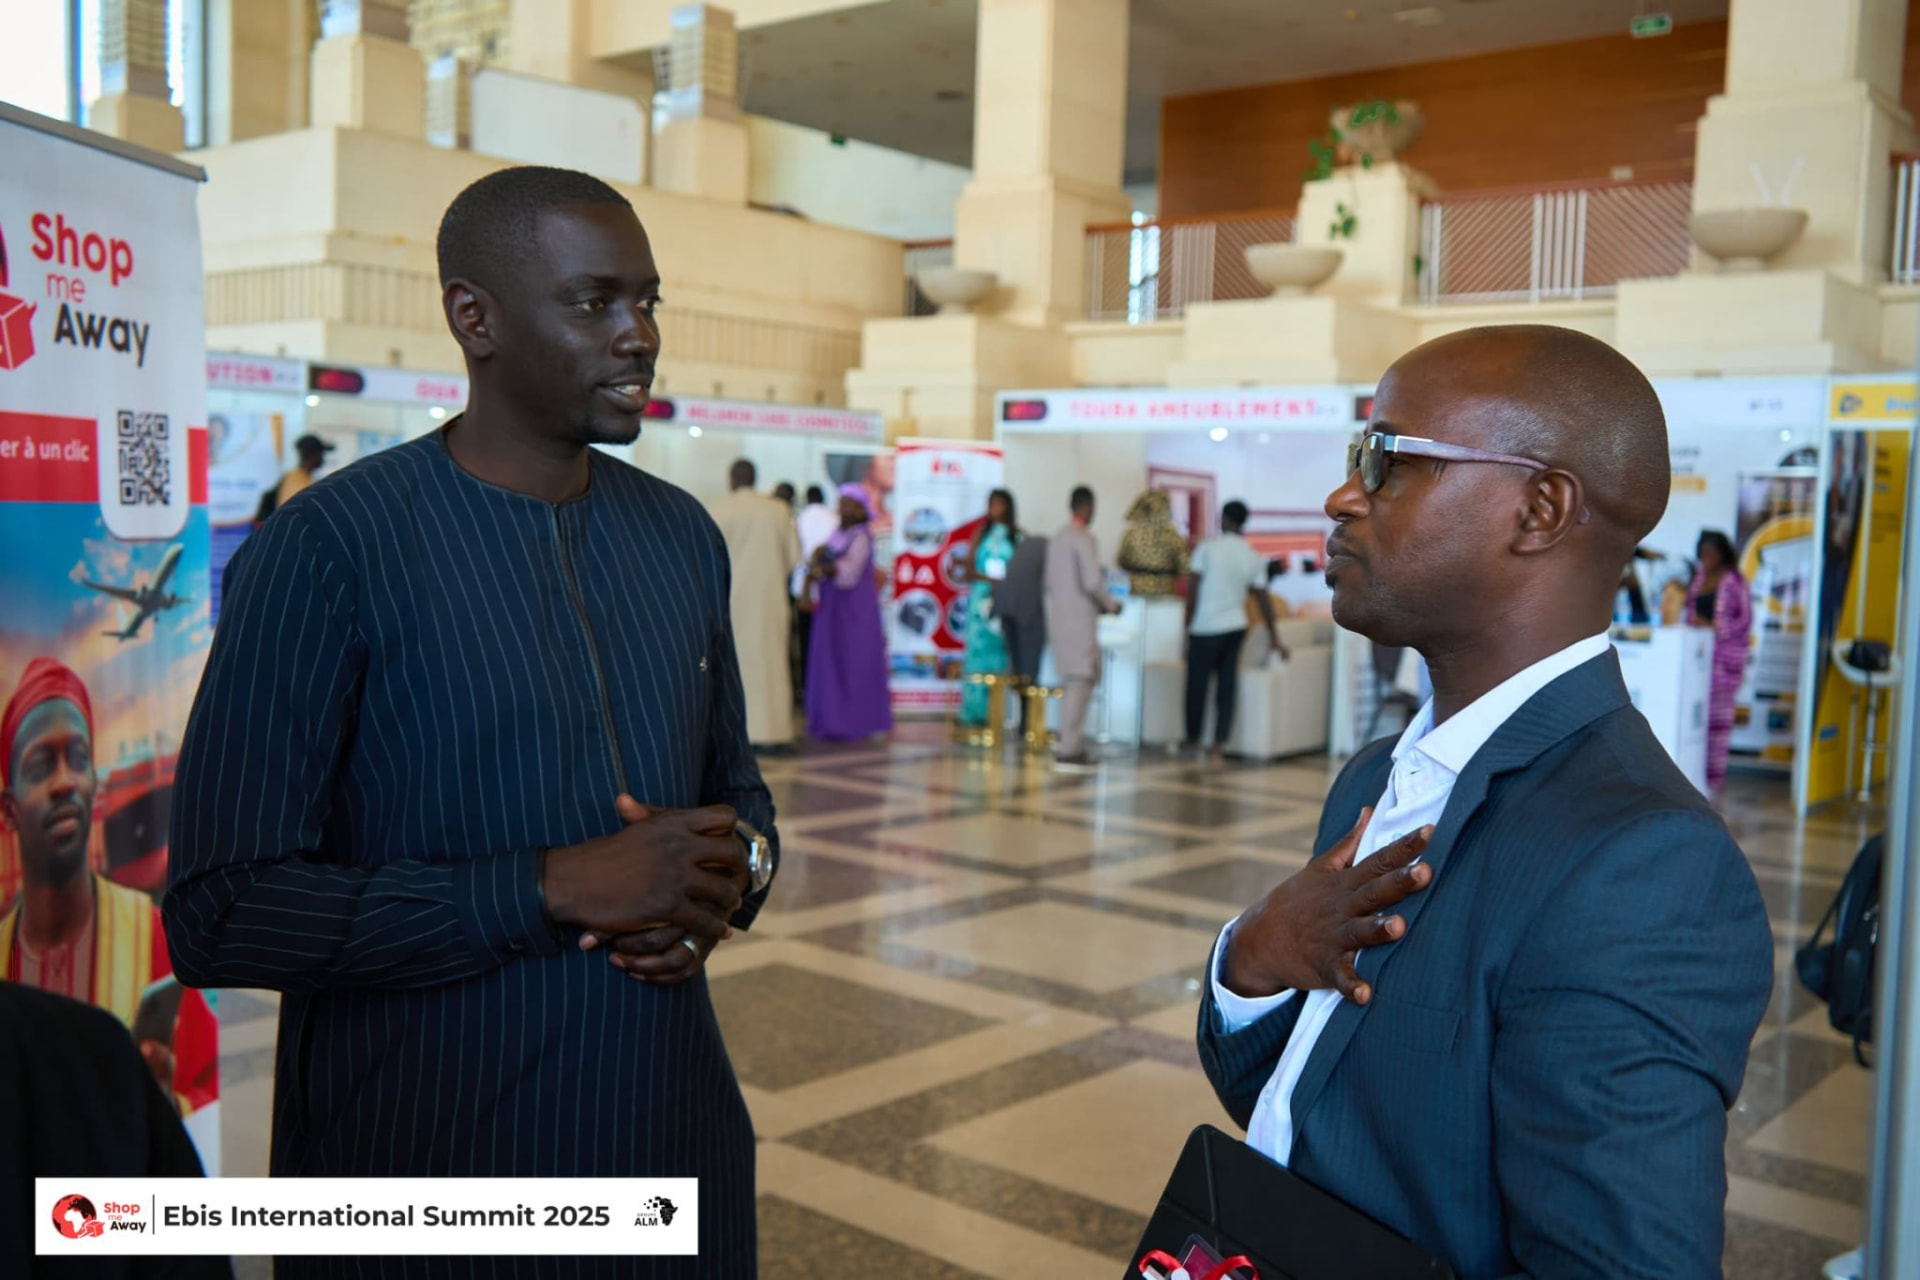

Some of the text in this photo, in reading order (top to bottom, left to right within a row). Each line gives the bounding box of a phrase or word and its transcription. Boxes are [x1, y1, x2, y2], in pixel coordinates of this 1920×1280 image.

[30, 212, 134, 286] Shop
[47, 272, 86, 302] me
[54, 303, 149, 368] Away
[1070, 400, 1137, 418] TOUBA
[1147, 399, 1316, 418] AMEUBLEMENT
[23, 435, 36, 459] à
[39, 442, 62, 461] un
